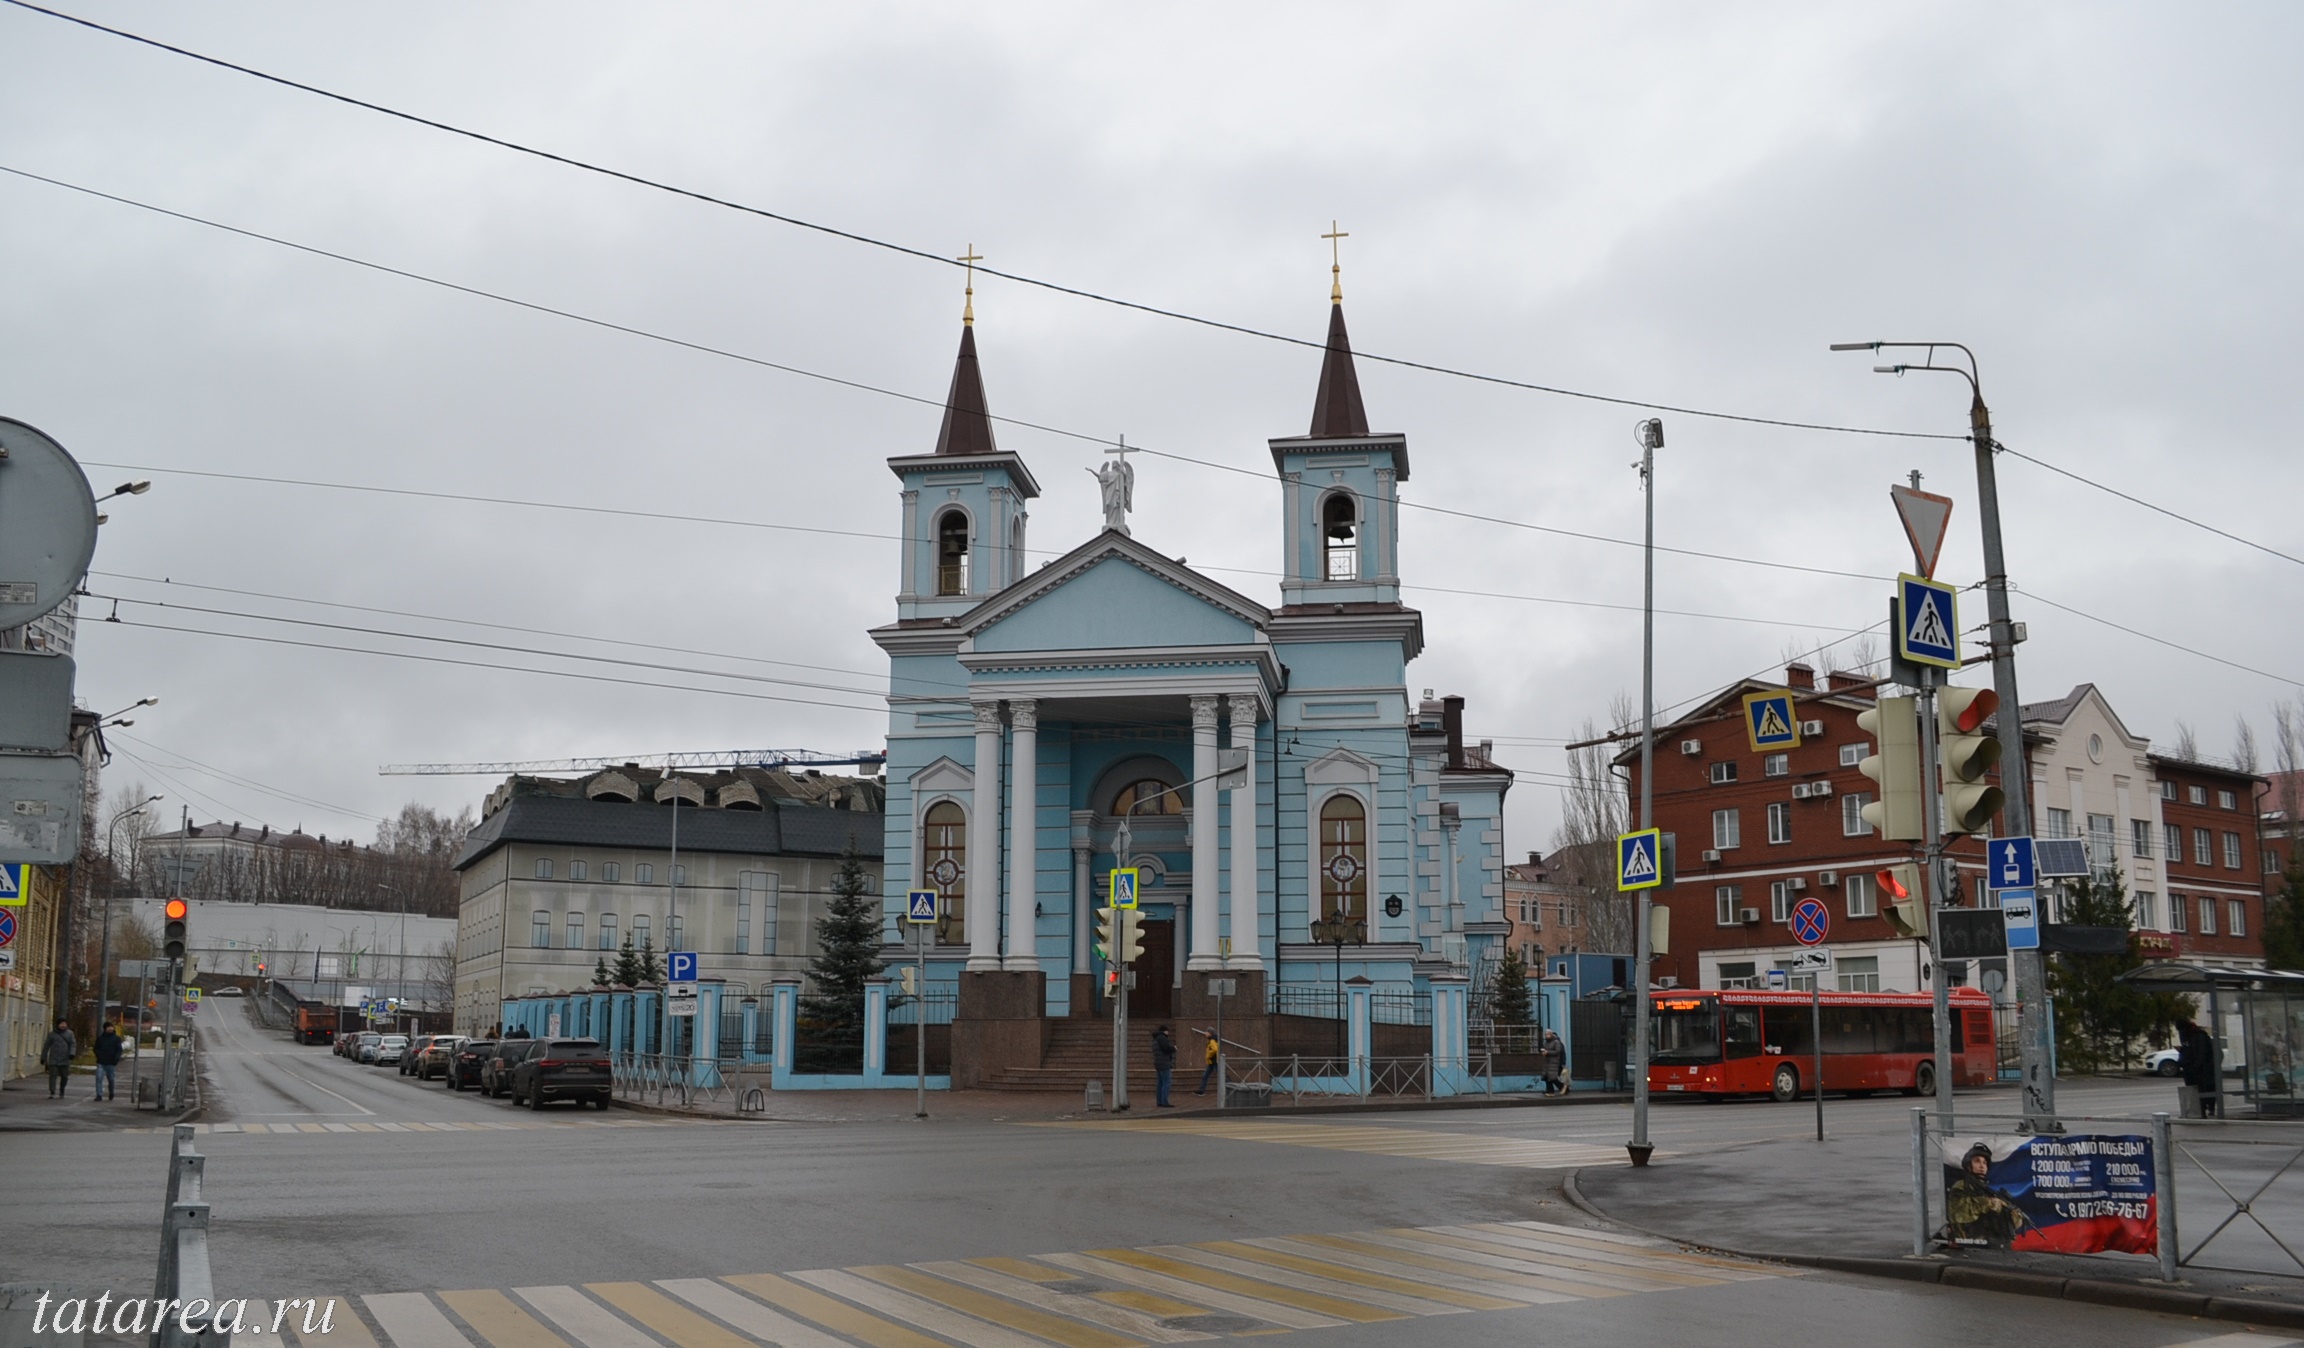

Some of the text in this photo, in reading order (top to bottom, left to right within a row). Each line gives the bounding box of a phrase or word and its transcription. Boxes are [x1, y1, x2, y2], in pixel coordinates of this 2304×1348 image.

[674, 956, 690, 979] P
[2099, 1142, 2144, 1156] ПОБЕДЫ!
[2037, 1160, 2053, 1172] 200
[2055, 1160, 2071, 1172] 000
[2106, 1163, 2120, 1175] 210
[2121, 1163, 2139, 1176] 000
[2036, 1175, 2053, 1187] 700
[2054, 1175, 2070, 1187] 000
[2068, 1202, 2077, 1218] 8
[2094, 1200, 2148, 1219] 256-76-67
